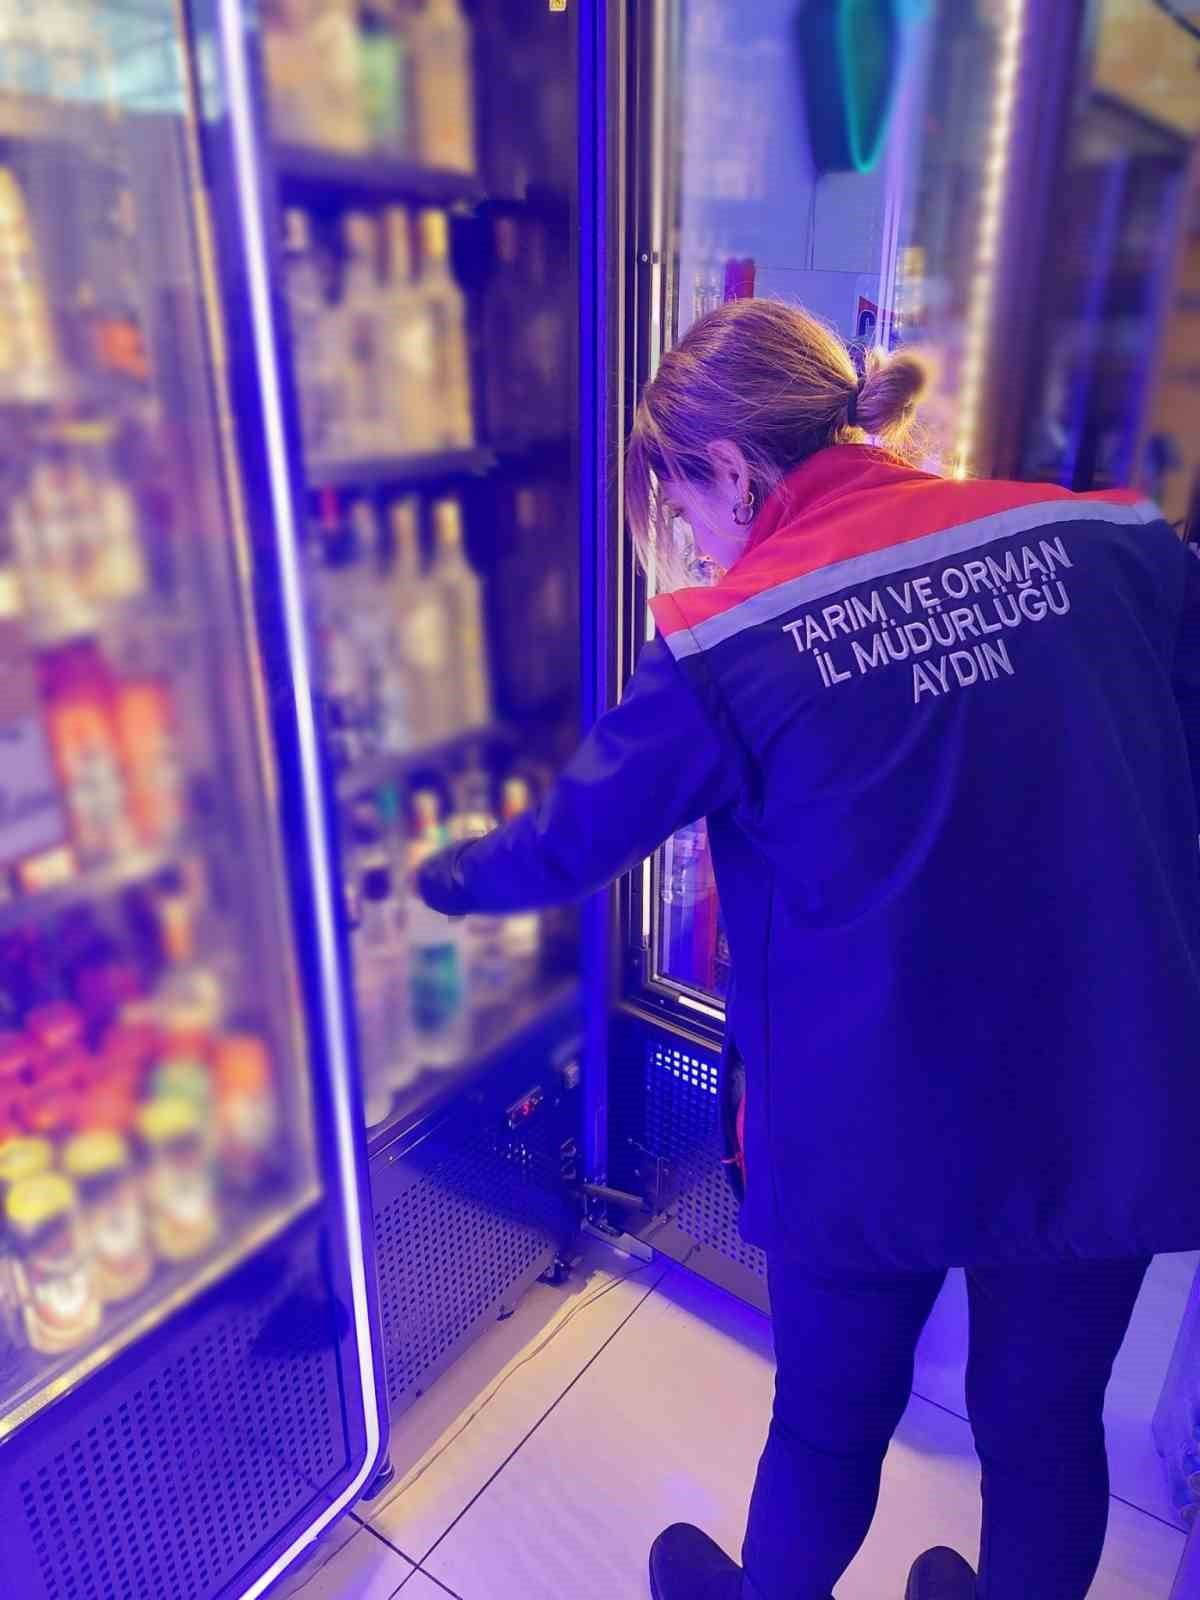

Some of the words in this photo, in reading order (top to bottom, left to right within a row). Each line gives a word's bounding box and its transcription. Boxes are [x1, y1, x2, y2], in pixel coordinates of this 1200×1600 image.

[782, 590, 888, 652] TARIM
[886, 576, 941, 614] VE
[941, 536, 1074, 601] ORMAN
[813, 648, 851, 688] İL
[851, 572, 1071, 674] MÜDÜRLÜĞÜ
[912, 638, 1015, 704] AYDIN
